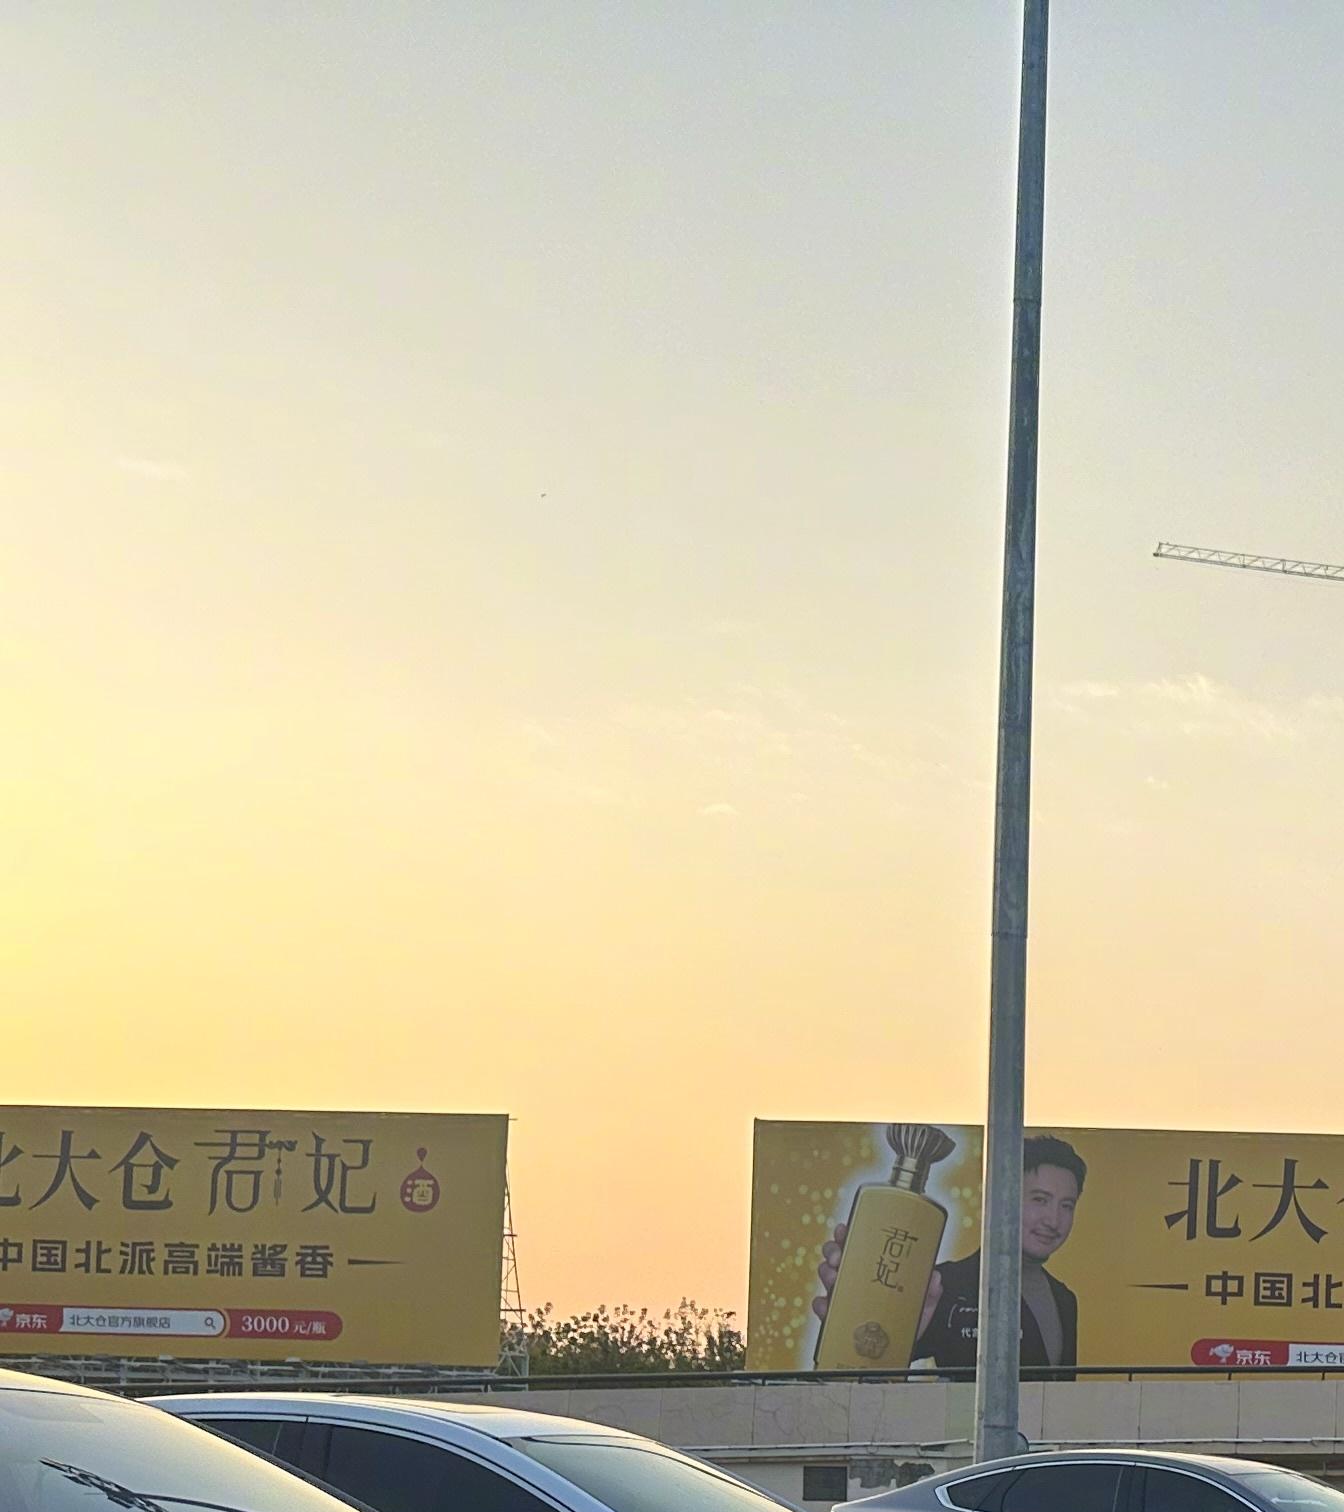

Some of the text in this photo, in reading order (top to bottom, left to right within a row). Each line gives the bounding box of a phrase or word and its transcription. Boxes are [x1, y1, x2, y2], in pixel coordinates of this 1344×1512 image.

[0, 1238, 334, 1279] 中国北派高端酱香
[15, 1314, 47, 1329] 京东
[69, 1314, 171, 1329] 北大仓官方旗舰店
[242, 1315, 289, 1333] 3000
[1236, 1350, 1271, 1365] 京东
